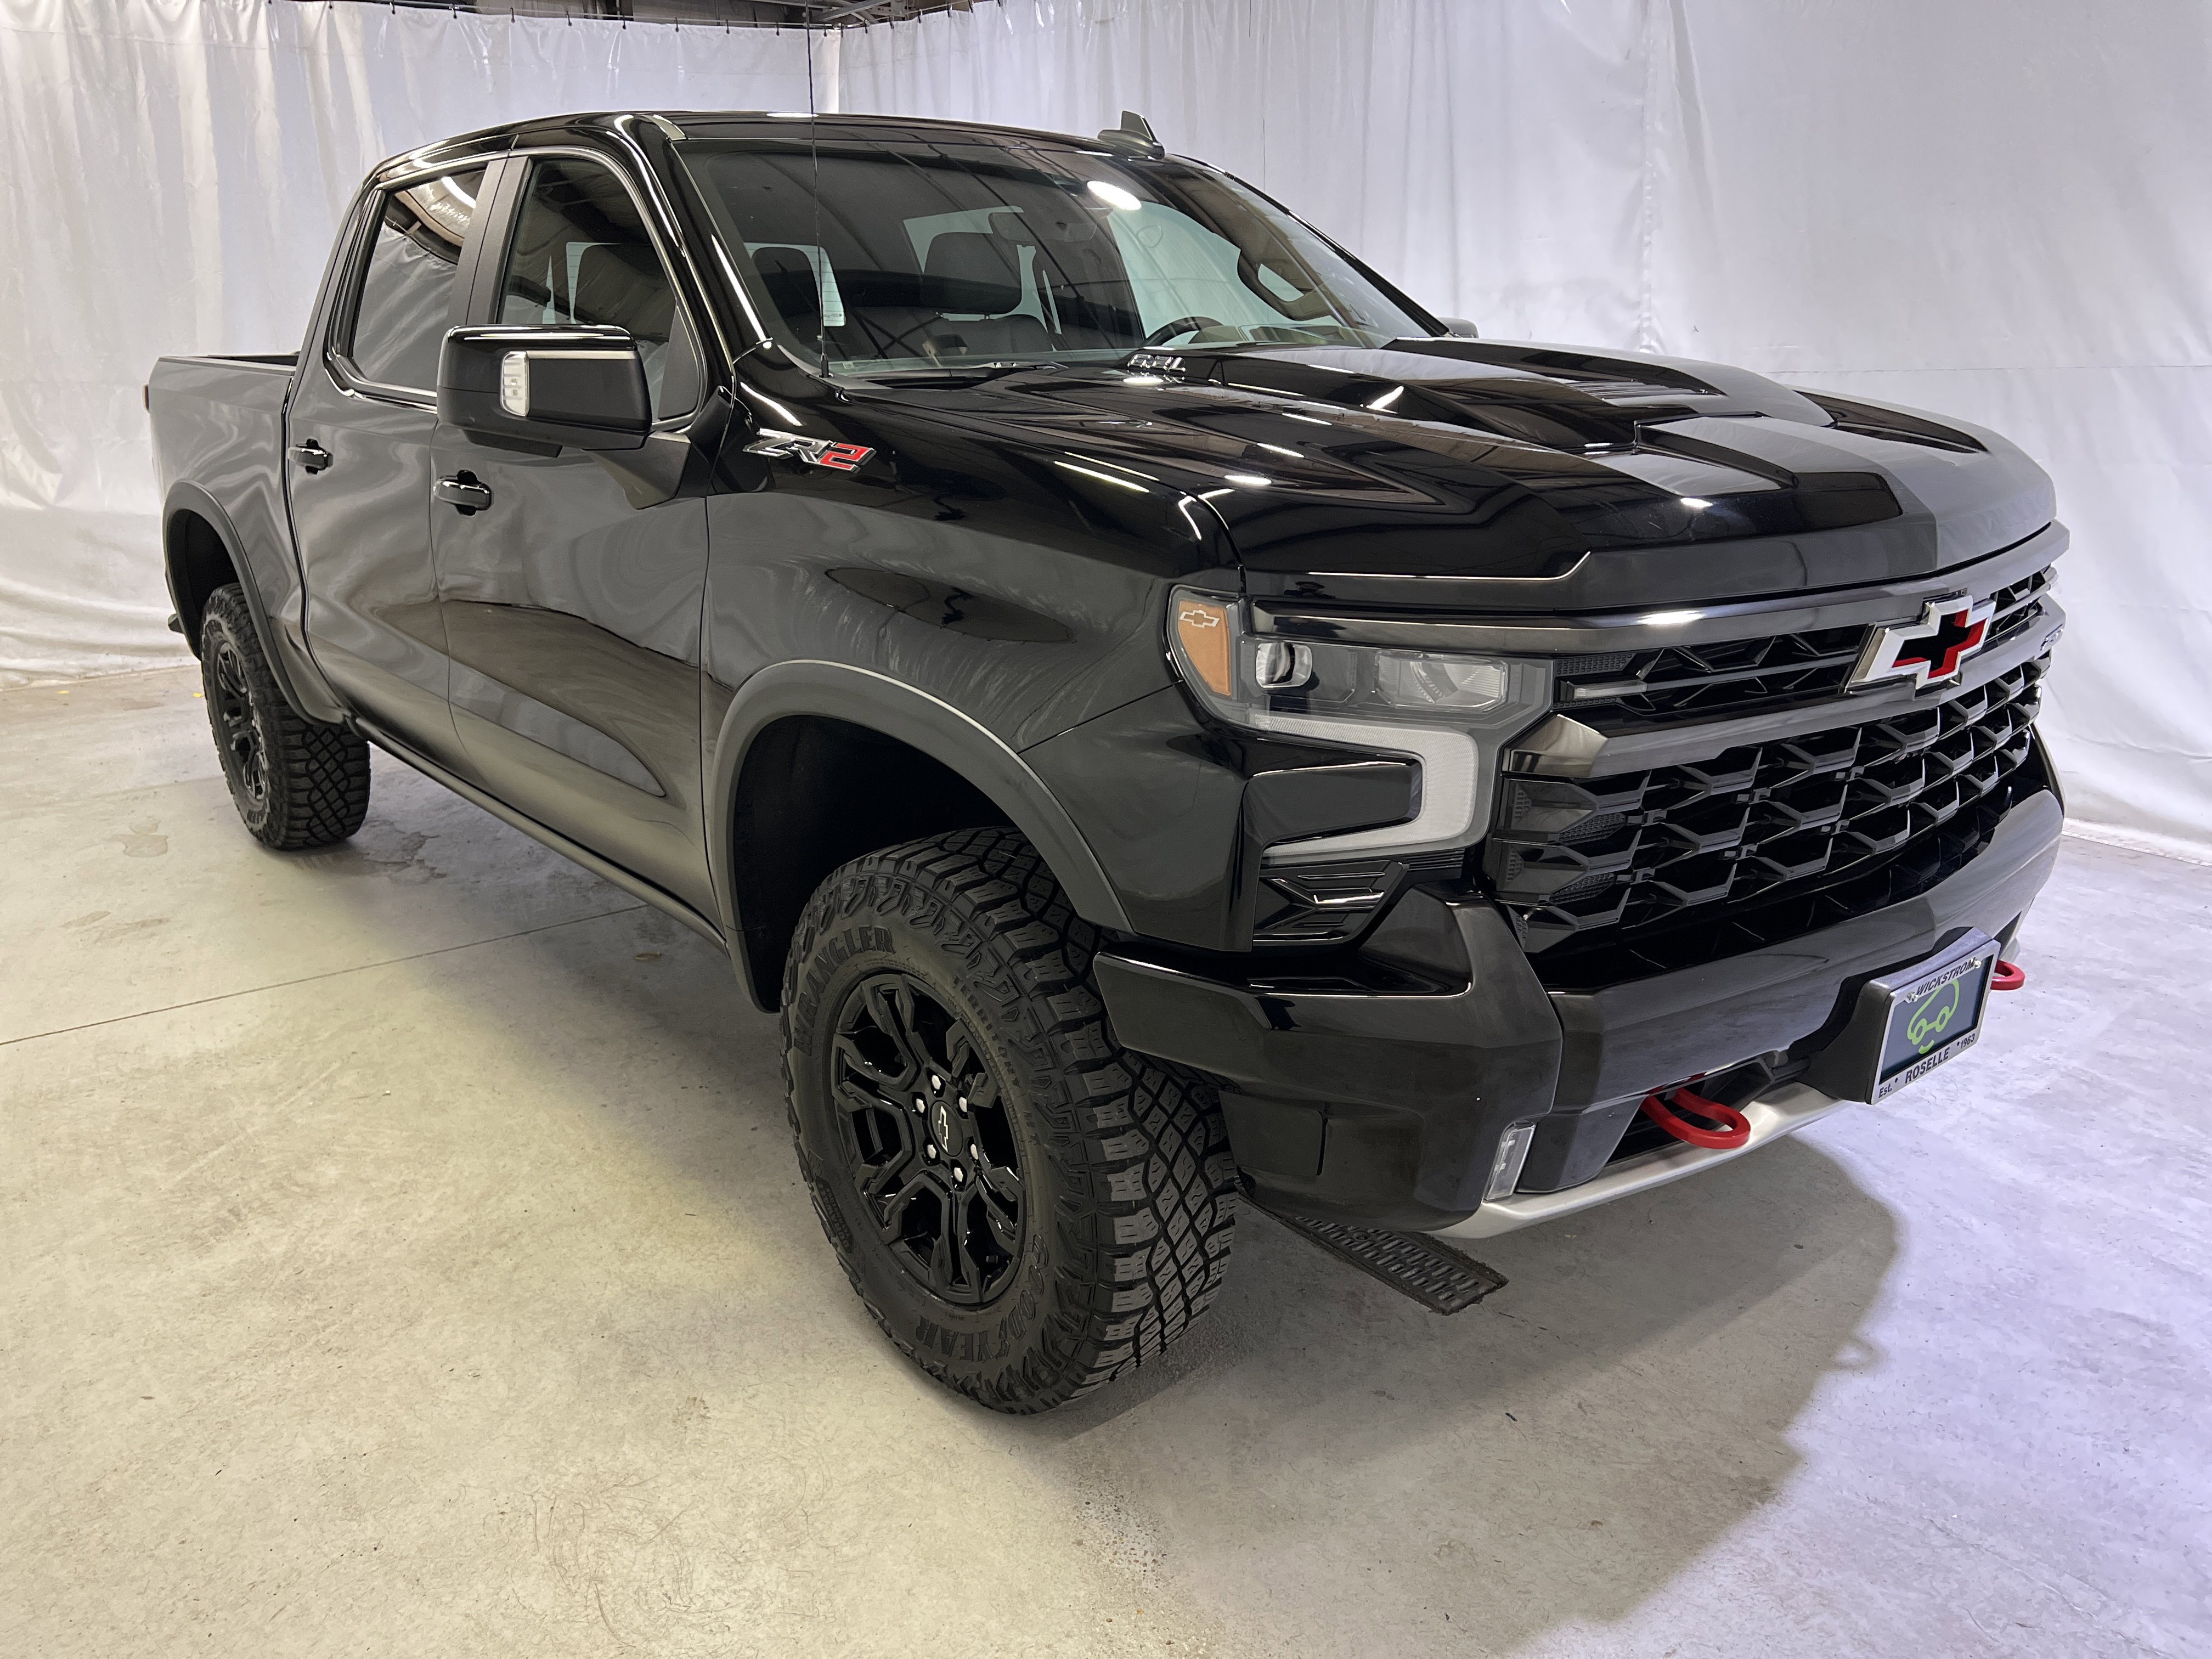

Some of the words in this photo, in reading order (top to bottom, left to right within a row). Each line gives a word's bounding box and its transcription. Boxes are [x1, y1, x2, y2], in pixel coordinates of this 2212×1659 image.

[742, 428, 877, 473] ZR2
[794, 926, 896, 1056] WRANGLER
[1917, 957, 1977, 996] WICKSTROM
[953, 973, 1022, 1088] TERRITORY
[1878, 1083, 1892, 1098] Est.
[1905, 1046, 1950, 1084] ROSELLE
[1960, 1033, 1976, 1049] 1963
[916, 1233, 1049, 1362] GOODYEAR
